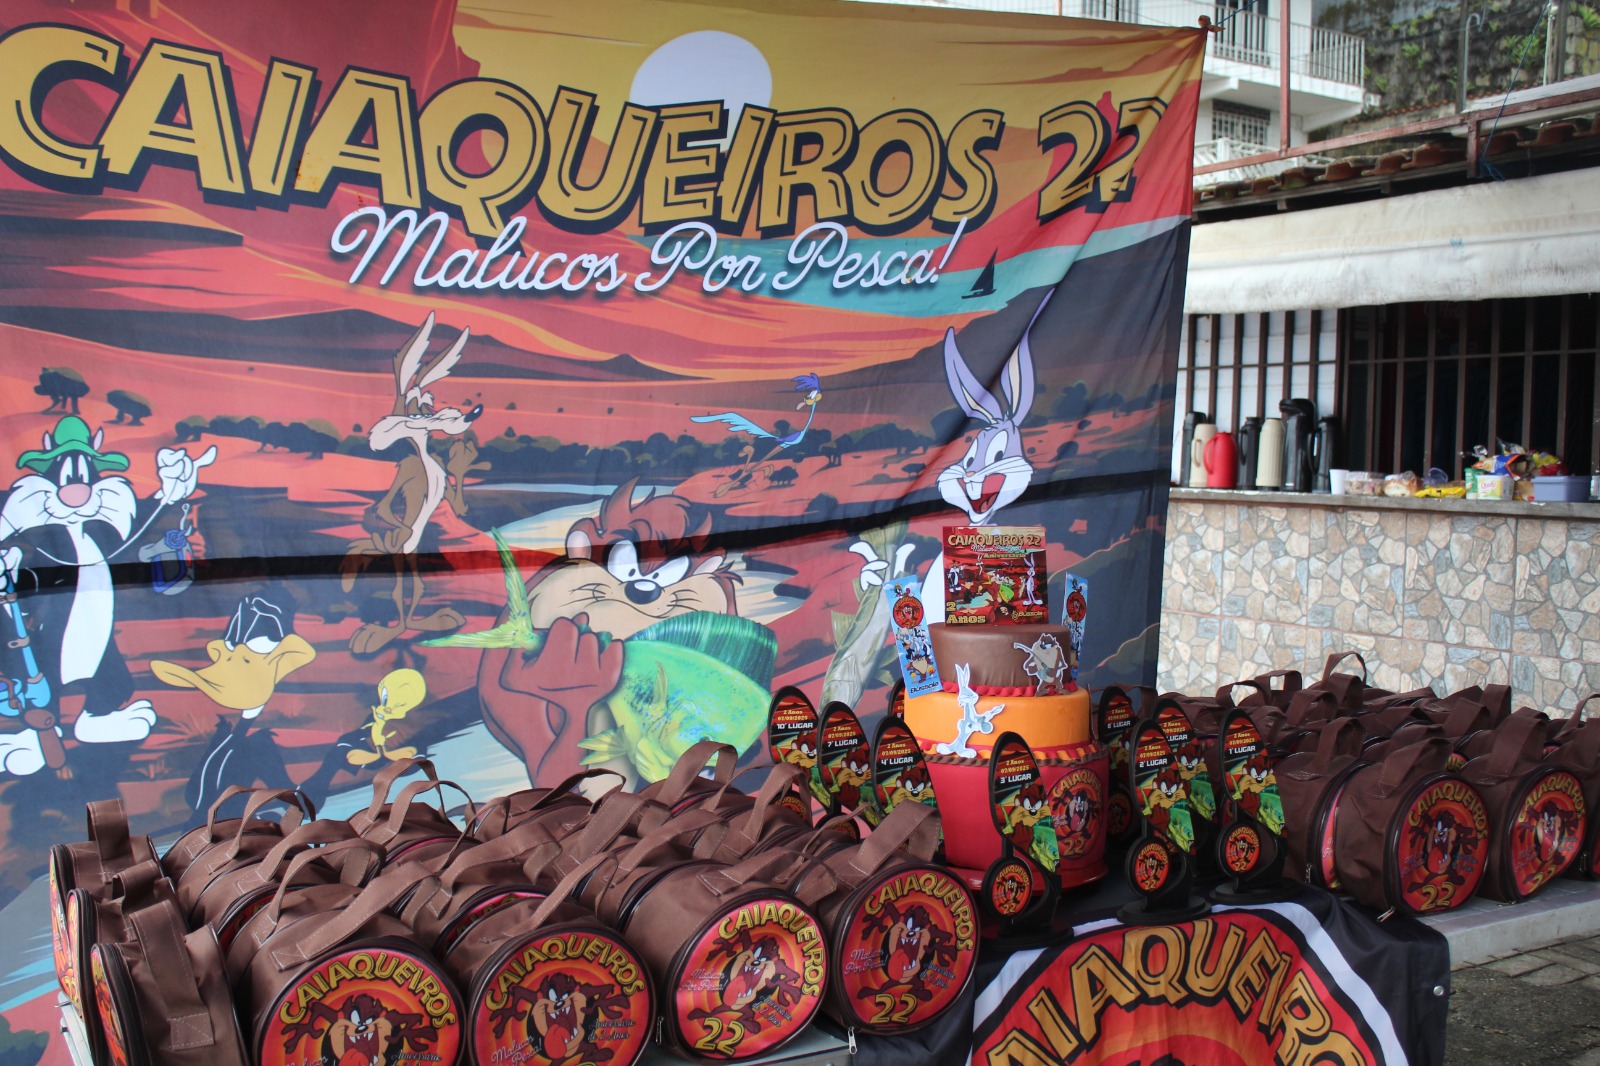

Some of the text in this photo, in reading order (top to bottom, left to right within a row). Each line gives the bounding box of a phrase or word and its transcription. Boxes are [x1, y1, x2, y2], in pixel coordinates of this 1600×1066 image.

[0, 21, 1168, 242] CAIAQUEIROS 22
[331, 206, 968, 292] Malucos Por Pesca!
[947, 533, 1041, 546] CAIAQUEIROS 22
[946, 601, 956, 612] 2
[946, 614, 986, 624] Anos
[1113, 720, 1131, 728] LUGAR
[834, 739, 858, 747] LUGAR
[1234, 745, 1256, 753] LUGAR
[889, 756, 914, 765] LUGAR
[1146, 758, 1168, 767] LUGAR
[1008, 773, 1032, 783] LUGAR
[1518, 773, 1586, 823] CAIAQUEIROS
[1407, 781, 1489, 840] CAIAQUEIROS
[1064, 837, 1086, 856] 22
[1235, 861, 1247, 872] 22
[1145, 880, 1157, 891] 22
[1420, 881, 1456, 911] 22
[864, 872, 974, 951] CAIAQUEIROS
[1003, 902, 1017, 915] 22
[718, 902, 825, 997] CAIAQUEIROS
[486, 934, 646, 1011] CAIAQUEIROS
[279, 952, 456, 1031] CAIAQUEIROS
[870, 993, 918, 1024] 22
[695, 1016, 746, 1056] 22
[491, 1035, 535, 1064] Malucos
